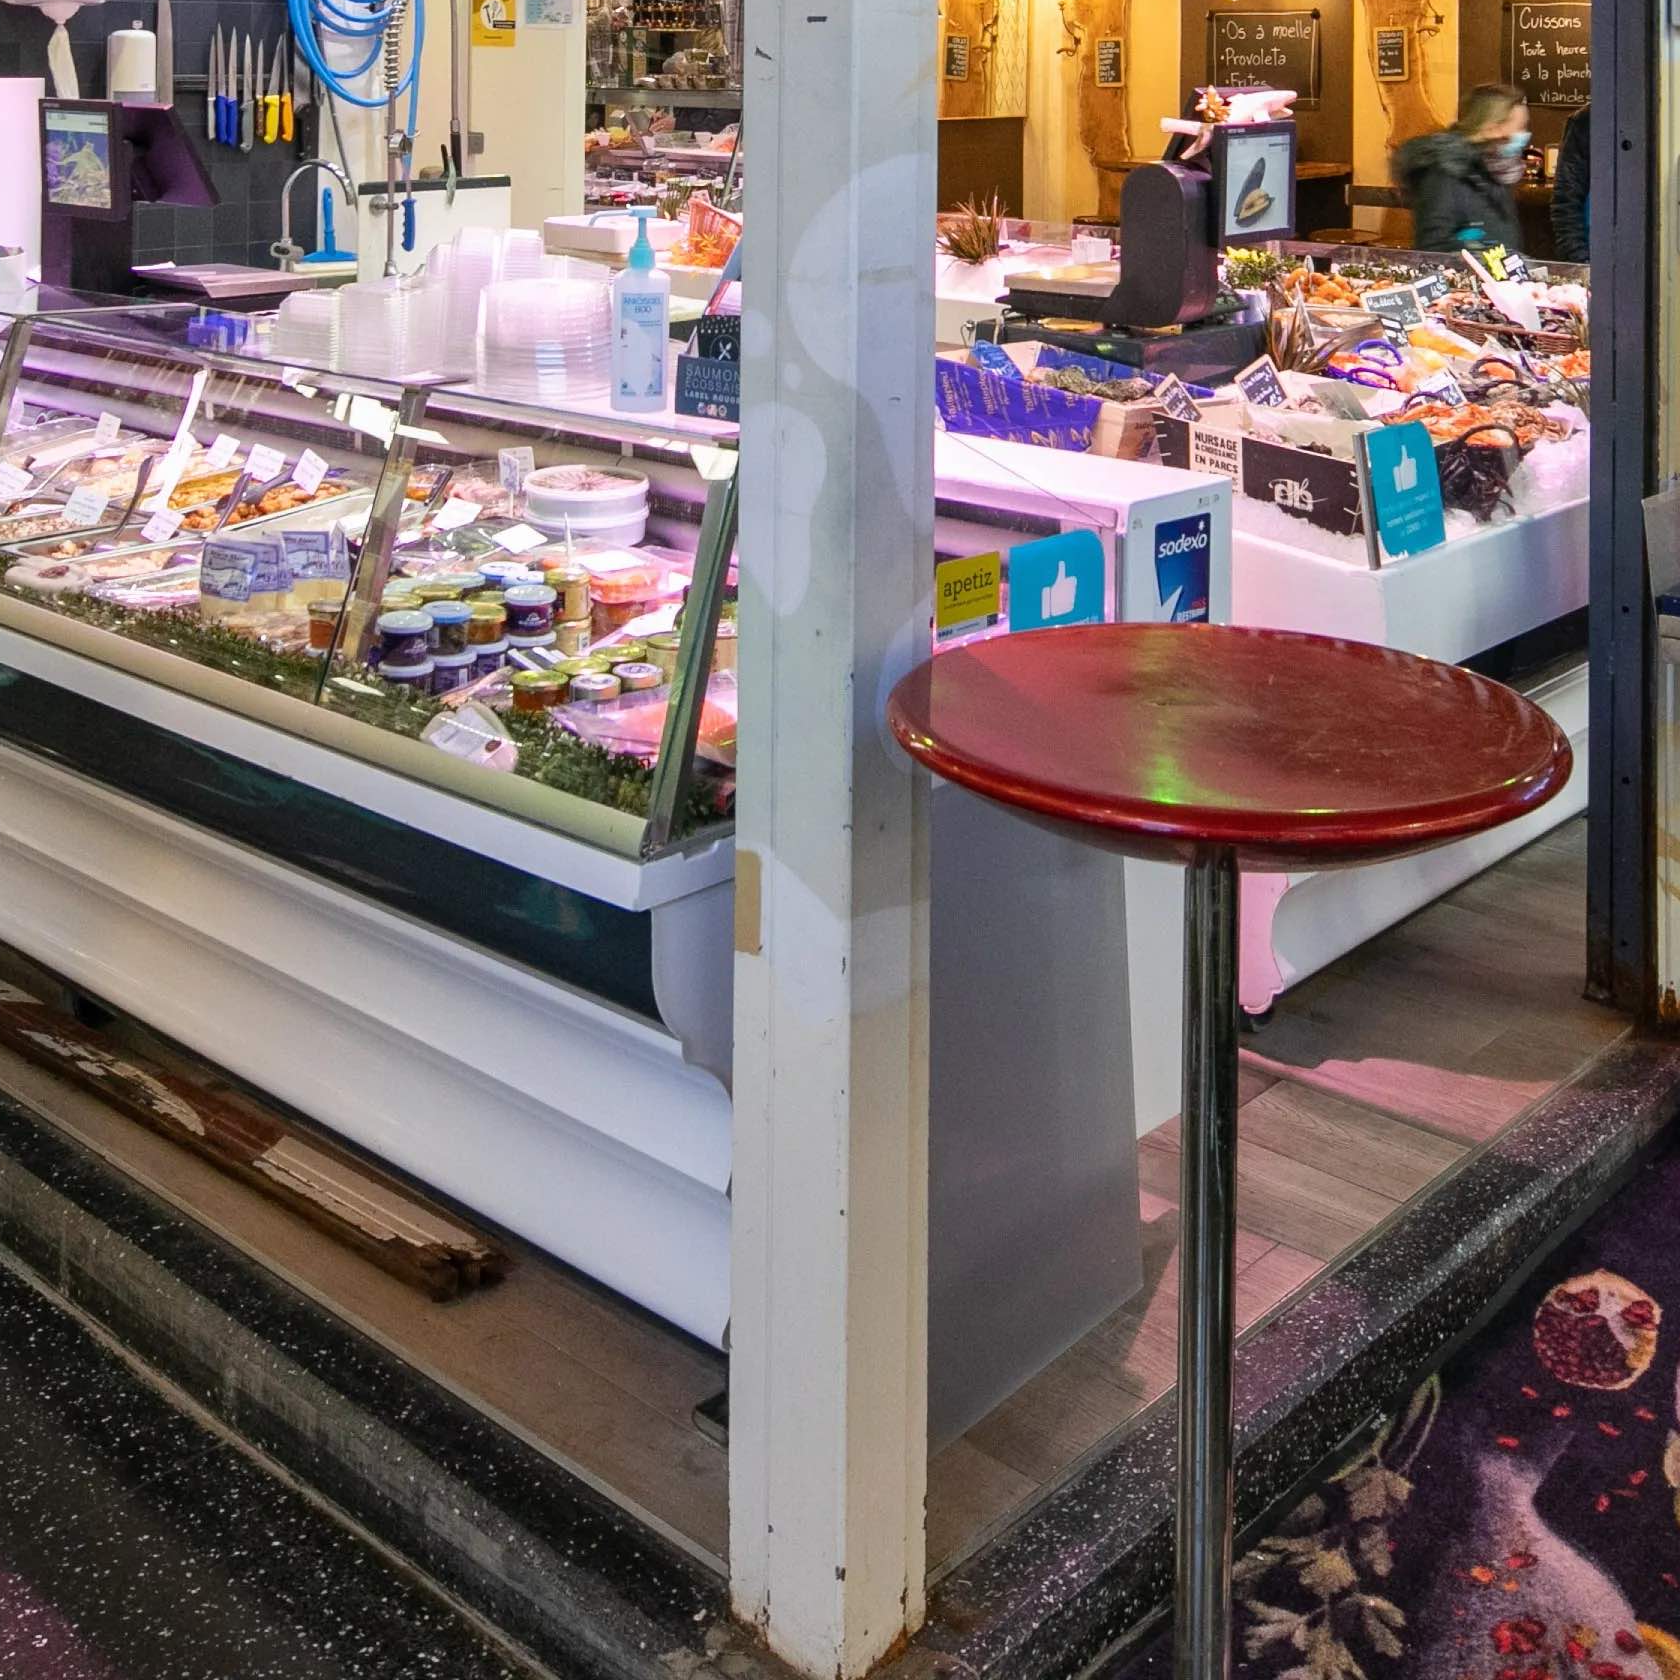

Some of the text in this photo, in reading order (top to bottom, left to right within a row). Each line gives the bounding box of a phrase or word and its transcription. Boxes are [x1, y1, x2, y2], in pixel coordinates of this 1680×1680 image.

[1520, 7, 1581, 29] Cuissons
[1226, 20, 1247, 40] Os
[1272, 20, 1313, 40] moelle
[1225, 47, 1287, 66] Provoleta
[1520, 41, 1588, 56] toute heure
[1538, 62, 1549, 80] la
[1557, 63, 1591, 87] planch
[1194, 432, 1238, 452] NURSAGE
[1194, 454, 1238, 474] EN PARCS
[1158, 531, 1208, 558] sodexo
[943, 569, 994, 602] apetiz
